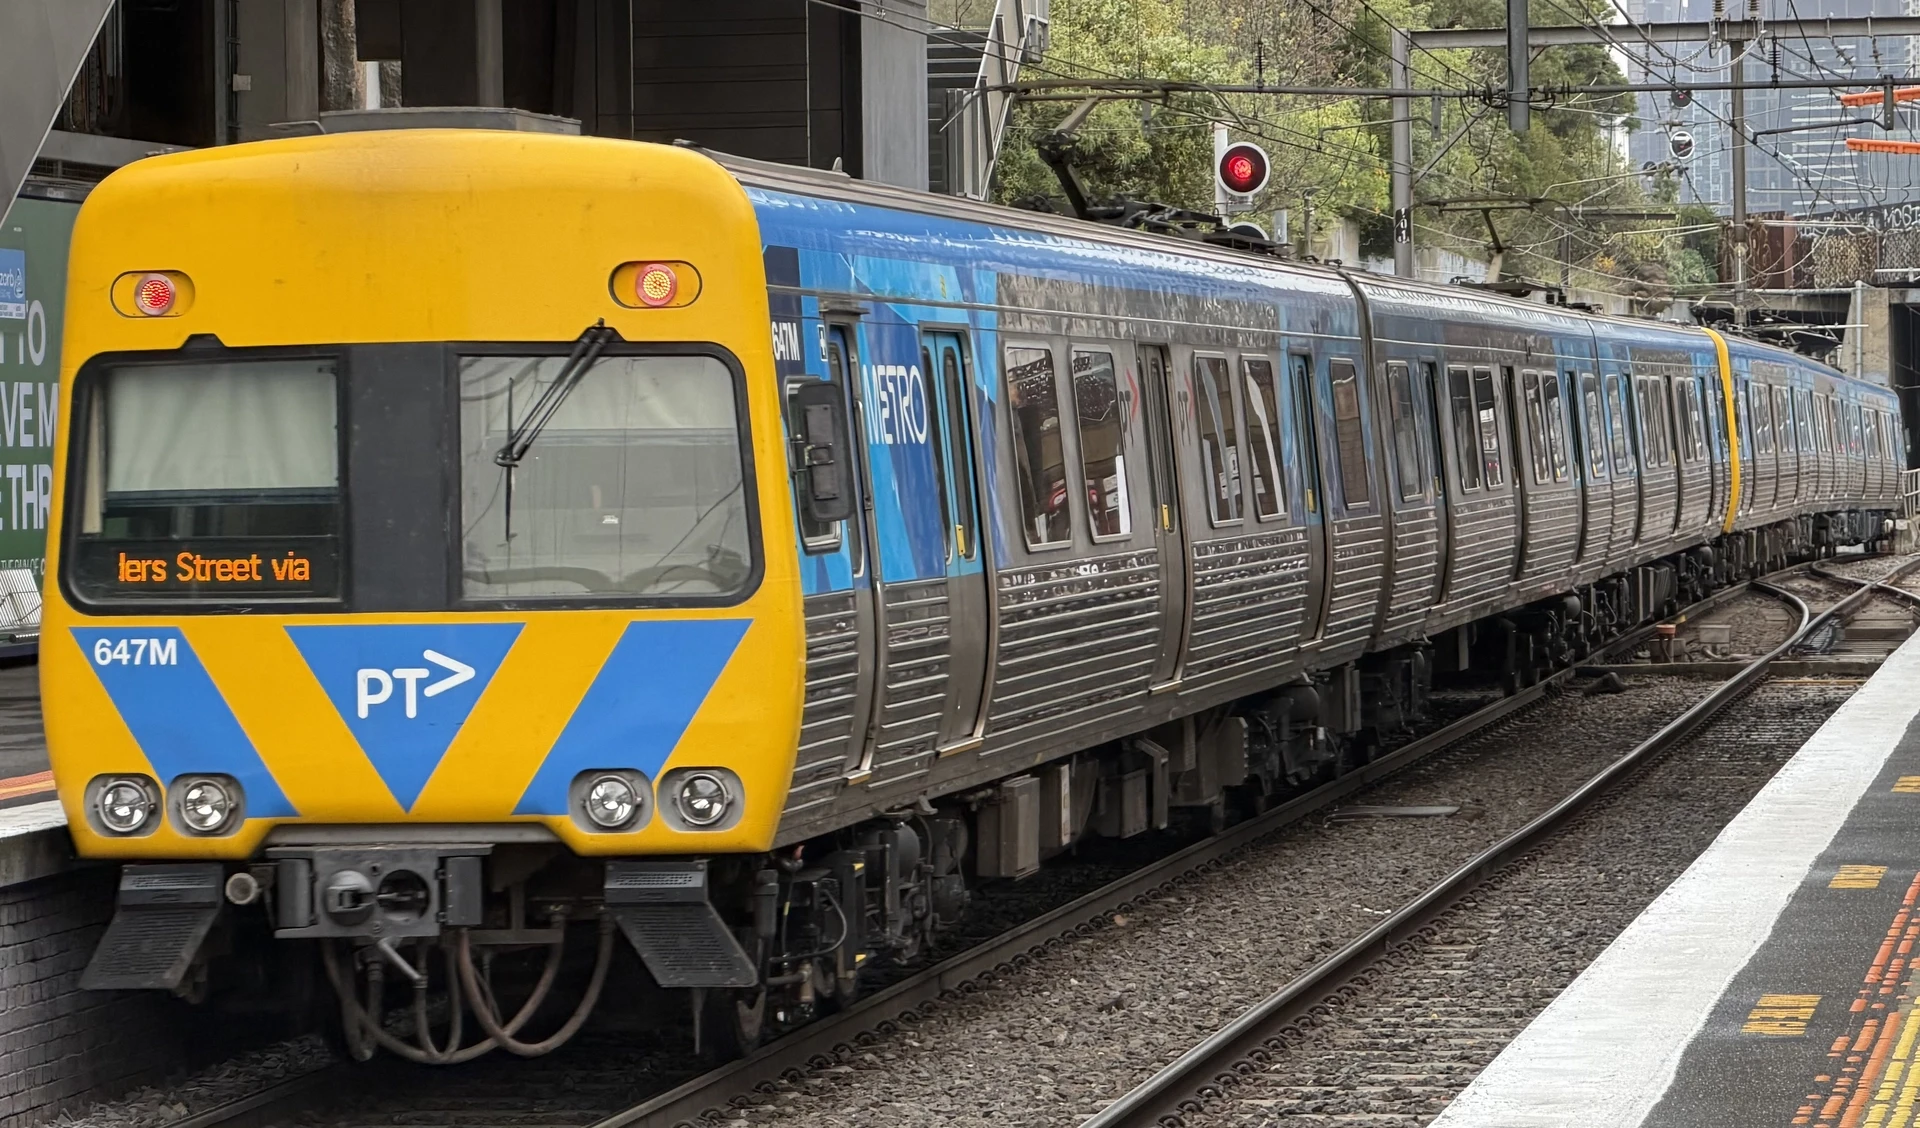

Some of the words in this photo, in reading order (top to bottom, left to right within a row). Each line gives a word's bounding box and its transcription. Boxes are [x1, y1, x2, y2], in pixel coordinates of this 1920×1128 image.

[771, 321, 800, 361] 647M
[0, 381, 34, 447] VE
[862, 364, 927, 445] METRO
[176, 552, 262, 582] Street
[272, 551, 310, 581] via
[94, 638, 178, 665] 647M
